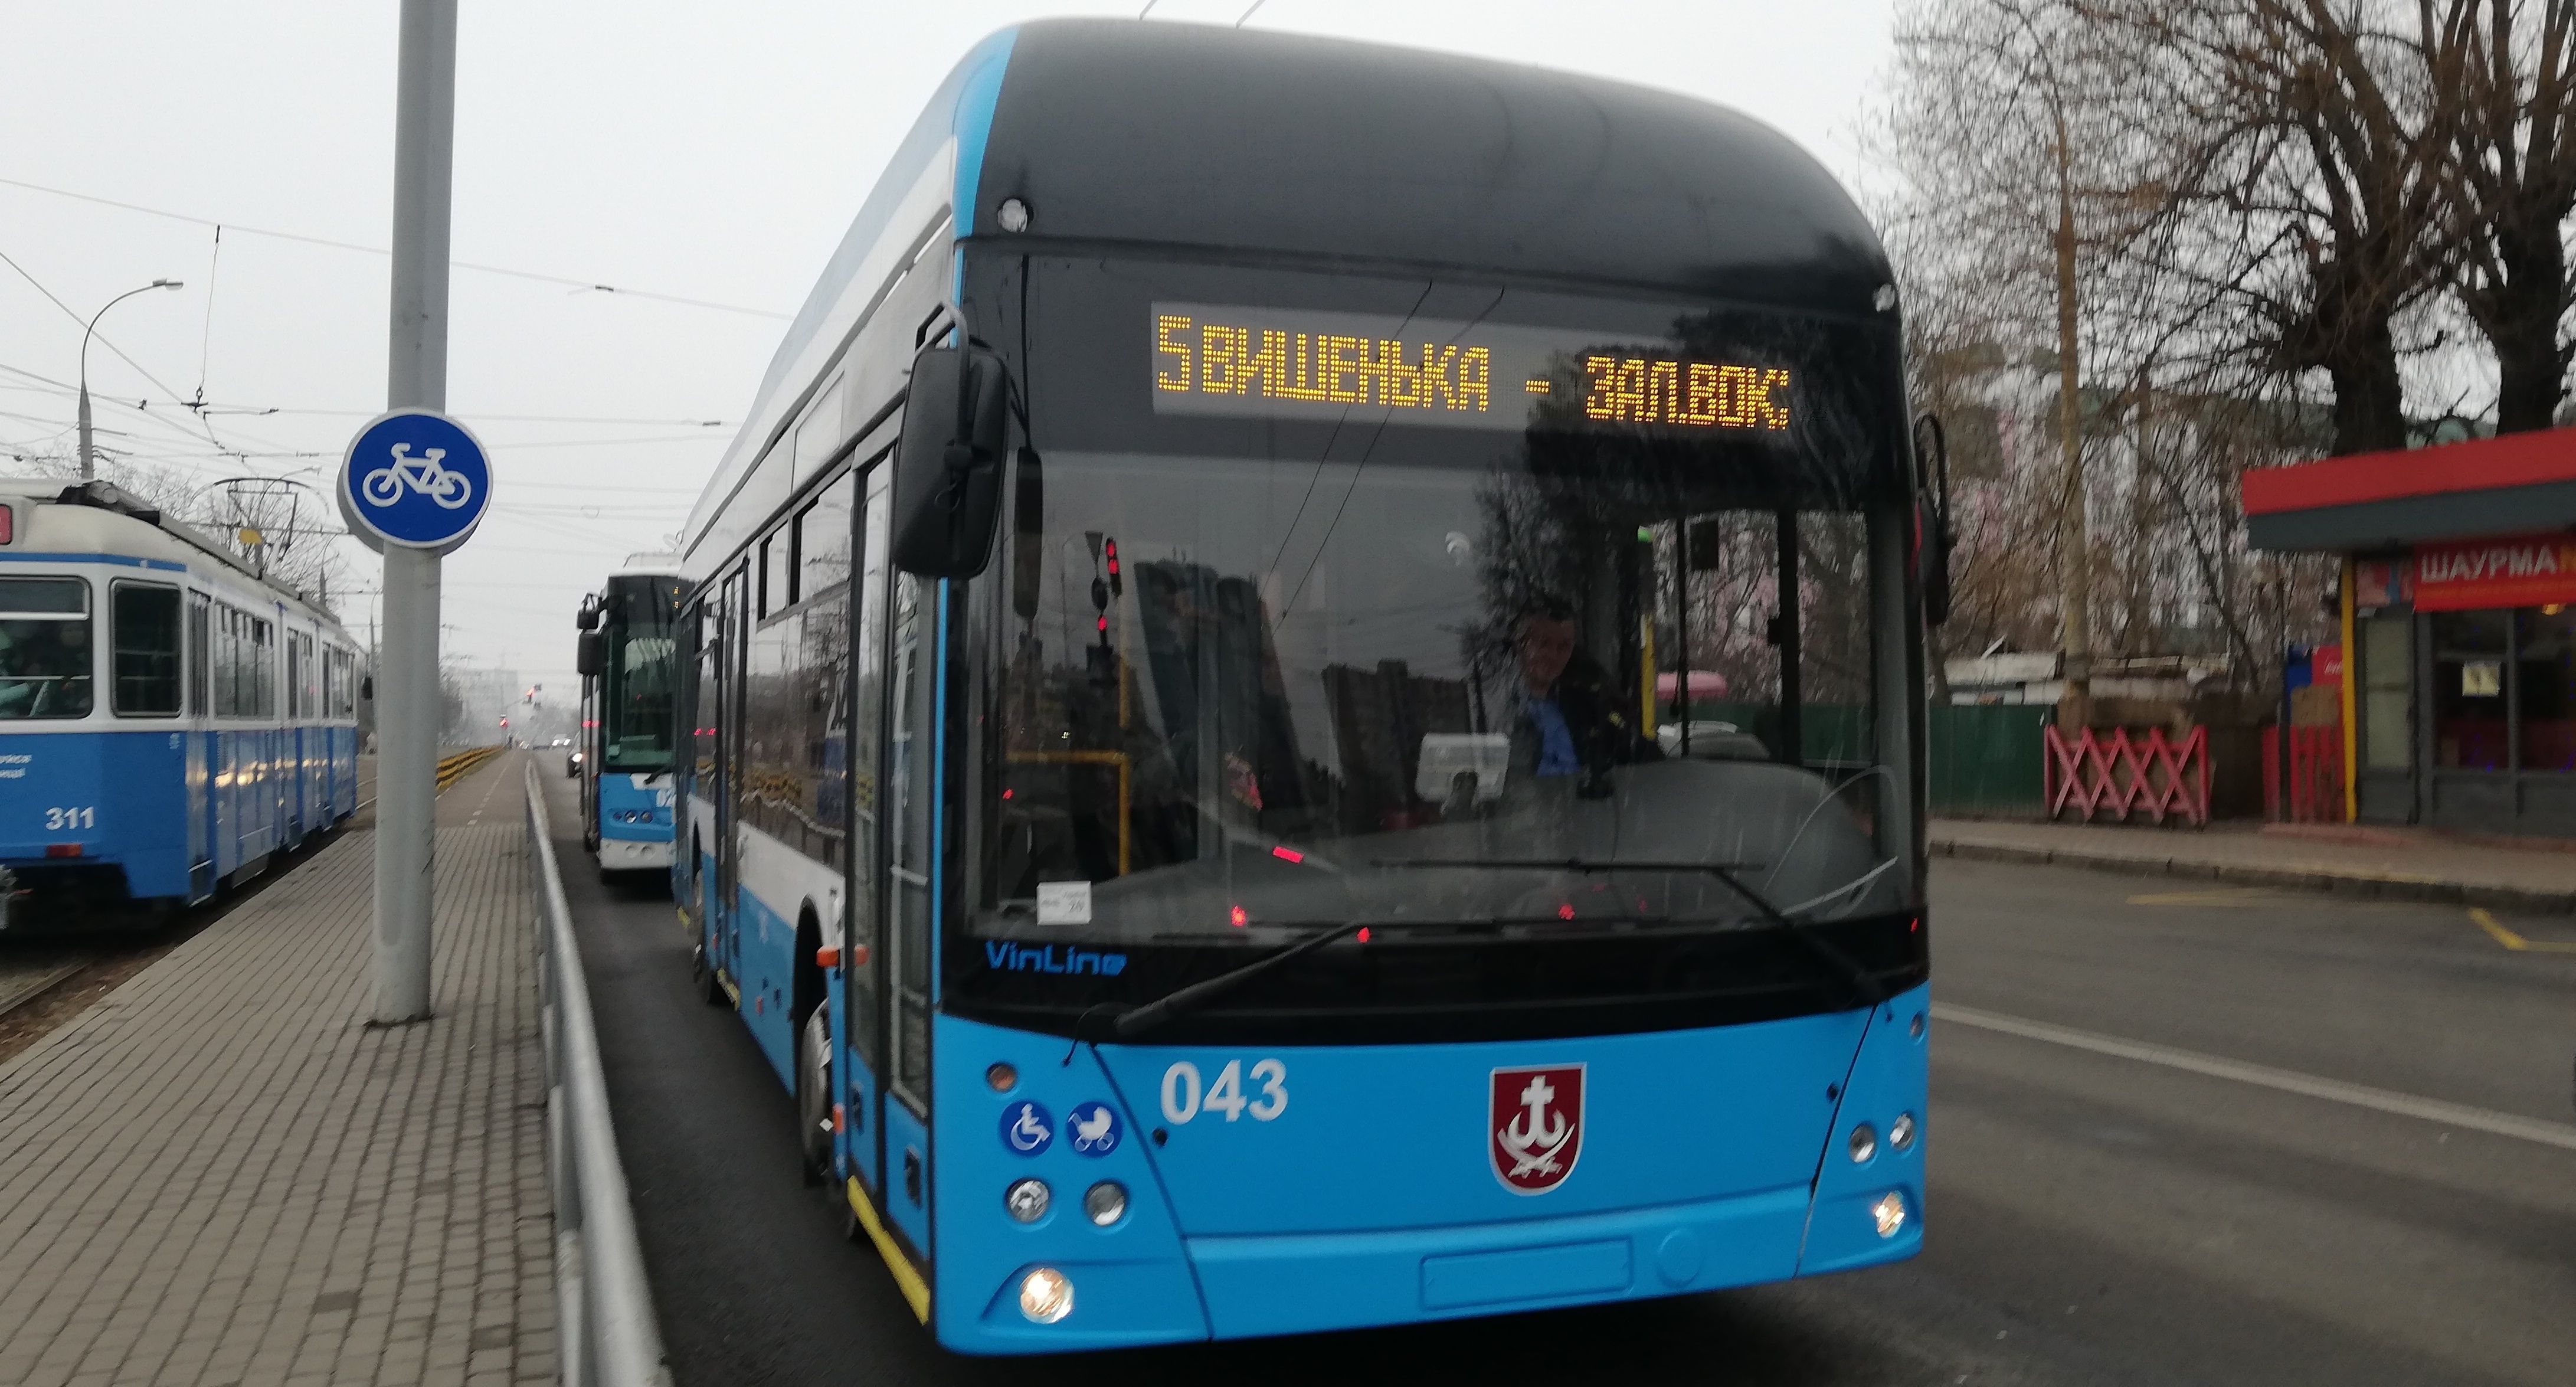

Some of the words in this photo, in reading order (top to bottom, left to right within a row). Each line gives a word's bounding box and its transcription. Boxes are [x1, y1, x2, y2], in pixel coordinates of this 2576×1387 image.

[1158, 315, 1190, 391] 5
[1202, 325, 1488, 412] ВИШЕНЬКА
[2421, 545, 2557, 583] ШАУРМА
[45, 806, 94, 830] 311
[1160, 1058, 1289, 1126] 043
